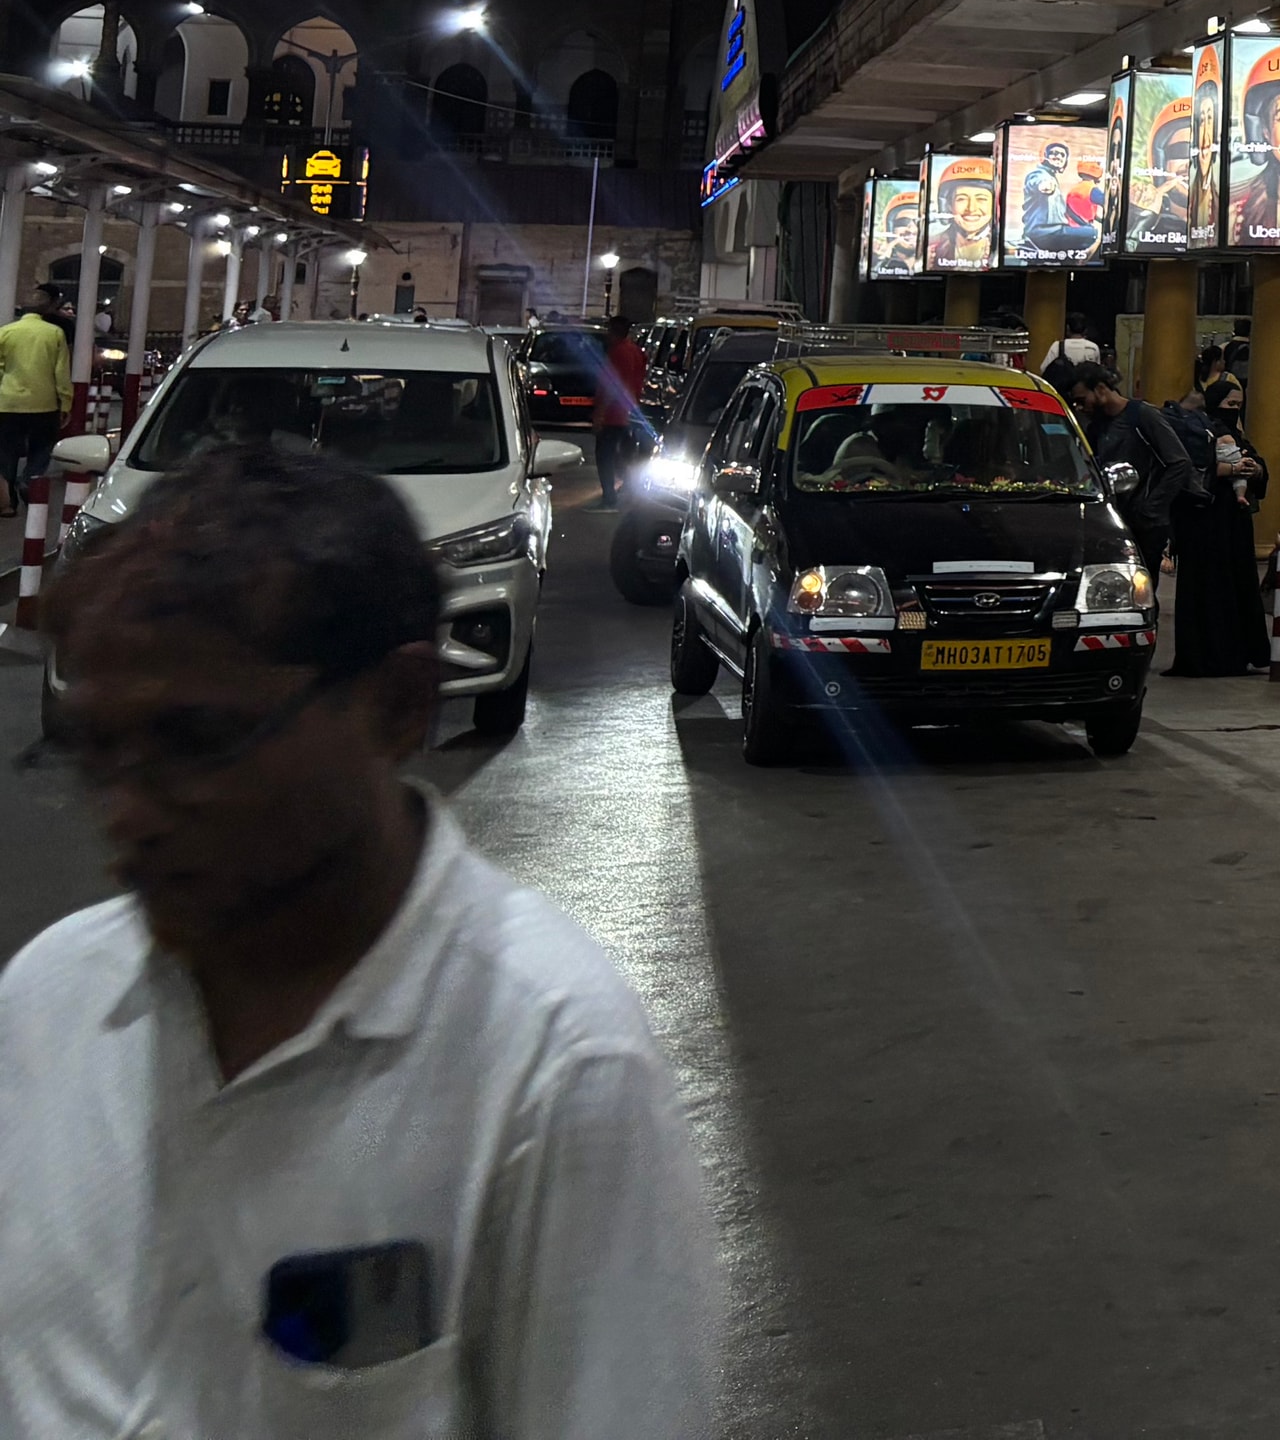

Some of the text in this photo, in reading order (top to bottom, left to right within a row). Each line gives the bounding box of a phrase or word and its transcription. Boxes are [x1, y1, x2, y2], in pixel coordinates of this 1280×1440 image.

[1138, 231, 1167, 243] Uber
[1249, 225, 1280, 238] Uber
[935, 644, 1047, 665] MH03AT1705
